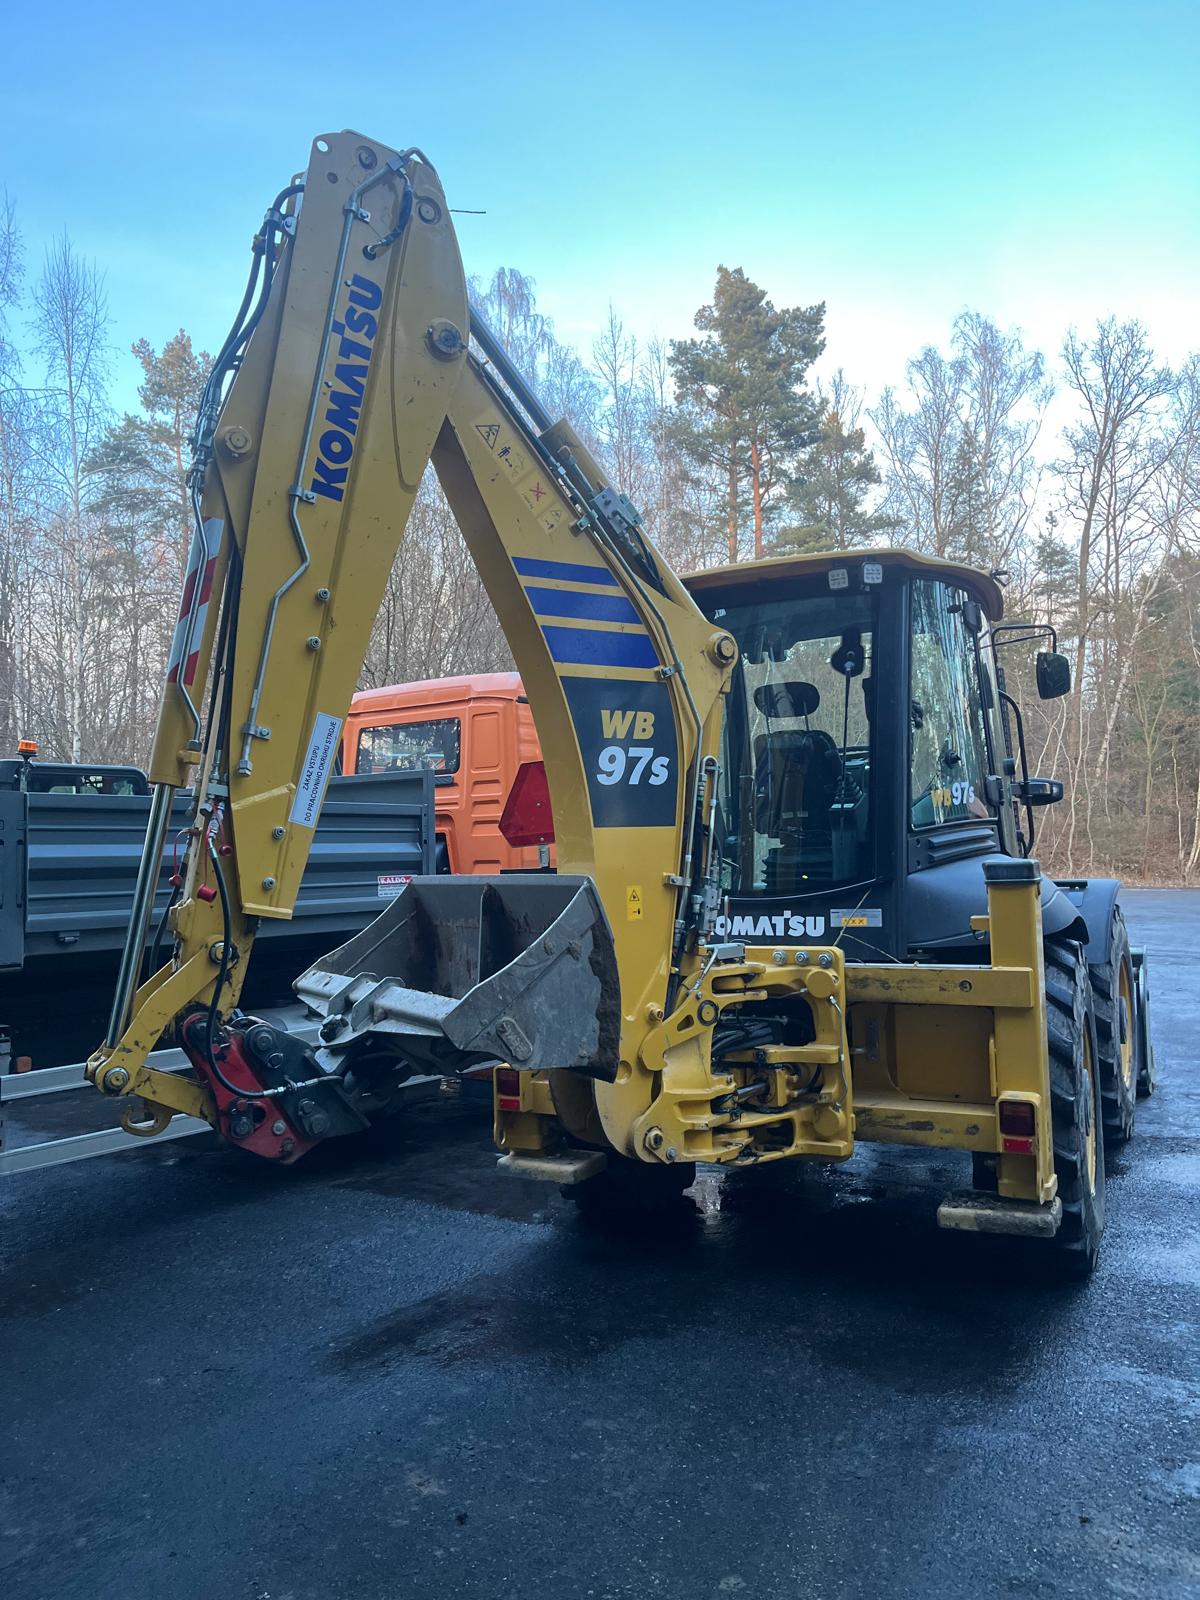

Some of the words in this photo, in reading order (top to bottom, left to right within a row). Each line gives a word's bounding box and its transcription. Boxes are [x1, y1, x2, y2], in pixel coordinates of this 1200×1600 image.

[311, 273, 383, 502] KOMATSU
[600, 709, 655, 740] WB
[304, 812, 312, 822] DO
[319, 745, 330, 771] OKRUHU
[325, 721, 337, 745] STROJE
[308, 745, 320, 769] VSTUPU
[596, 745, 670, 786] 97s
[709, 910, 825, 937] OMATSU
